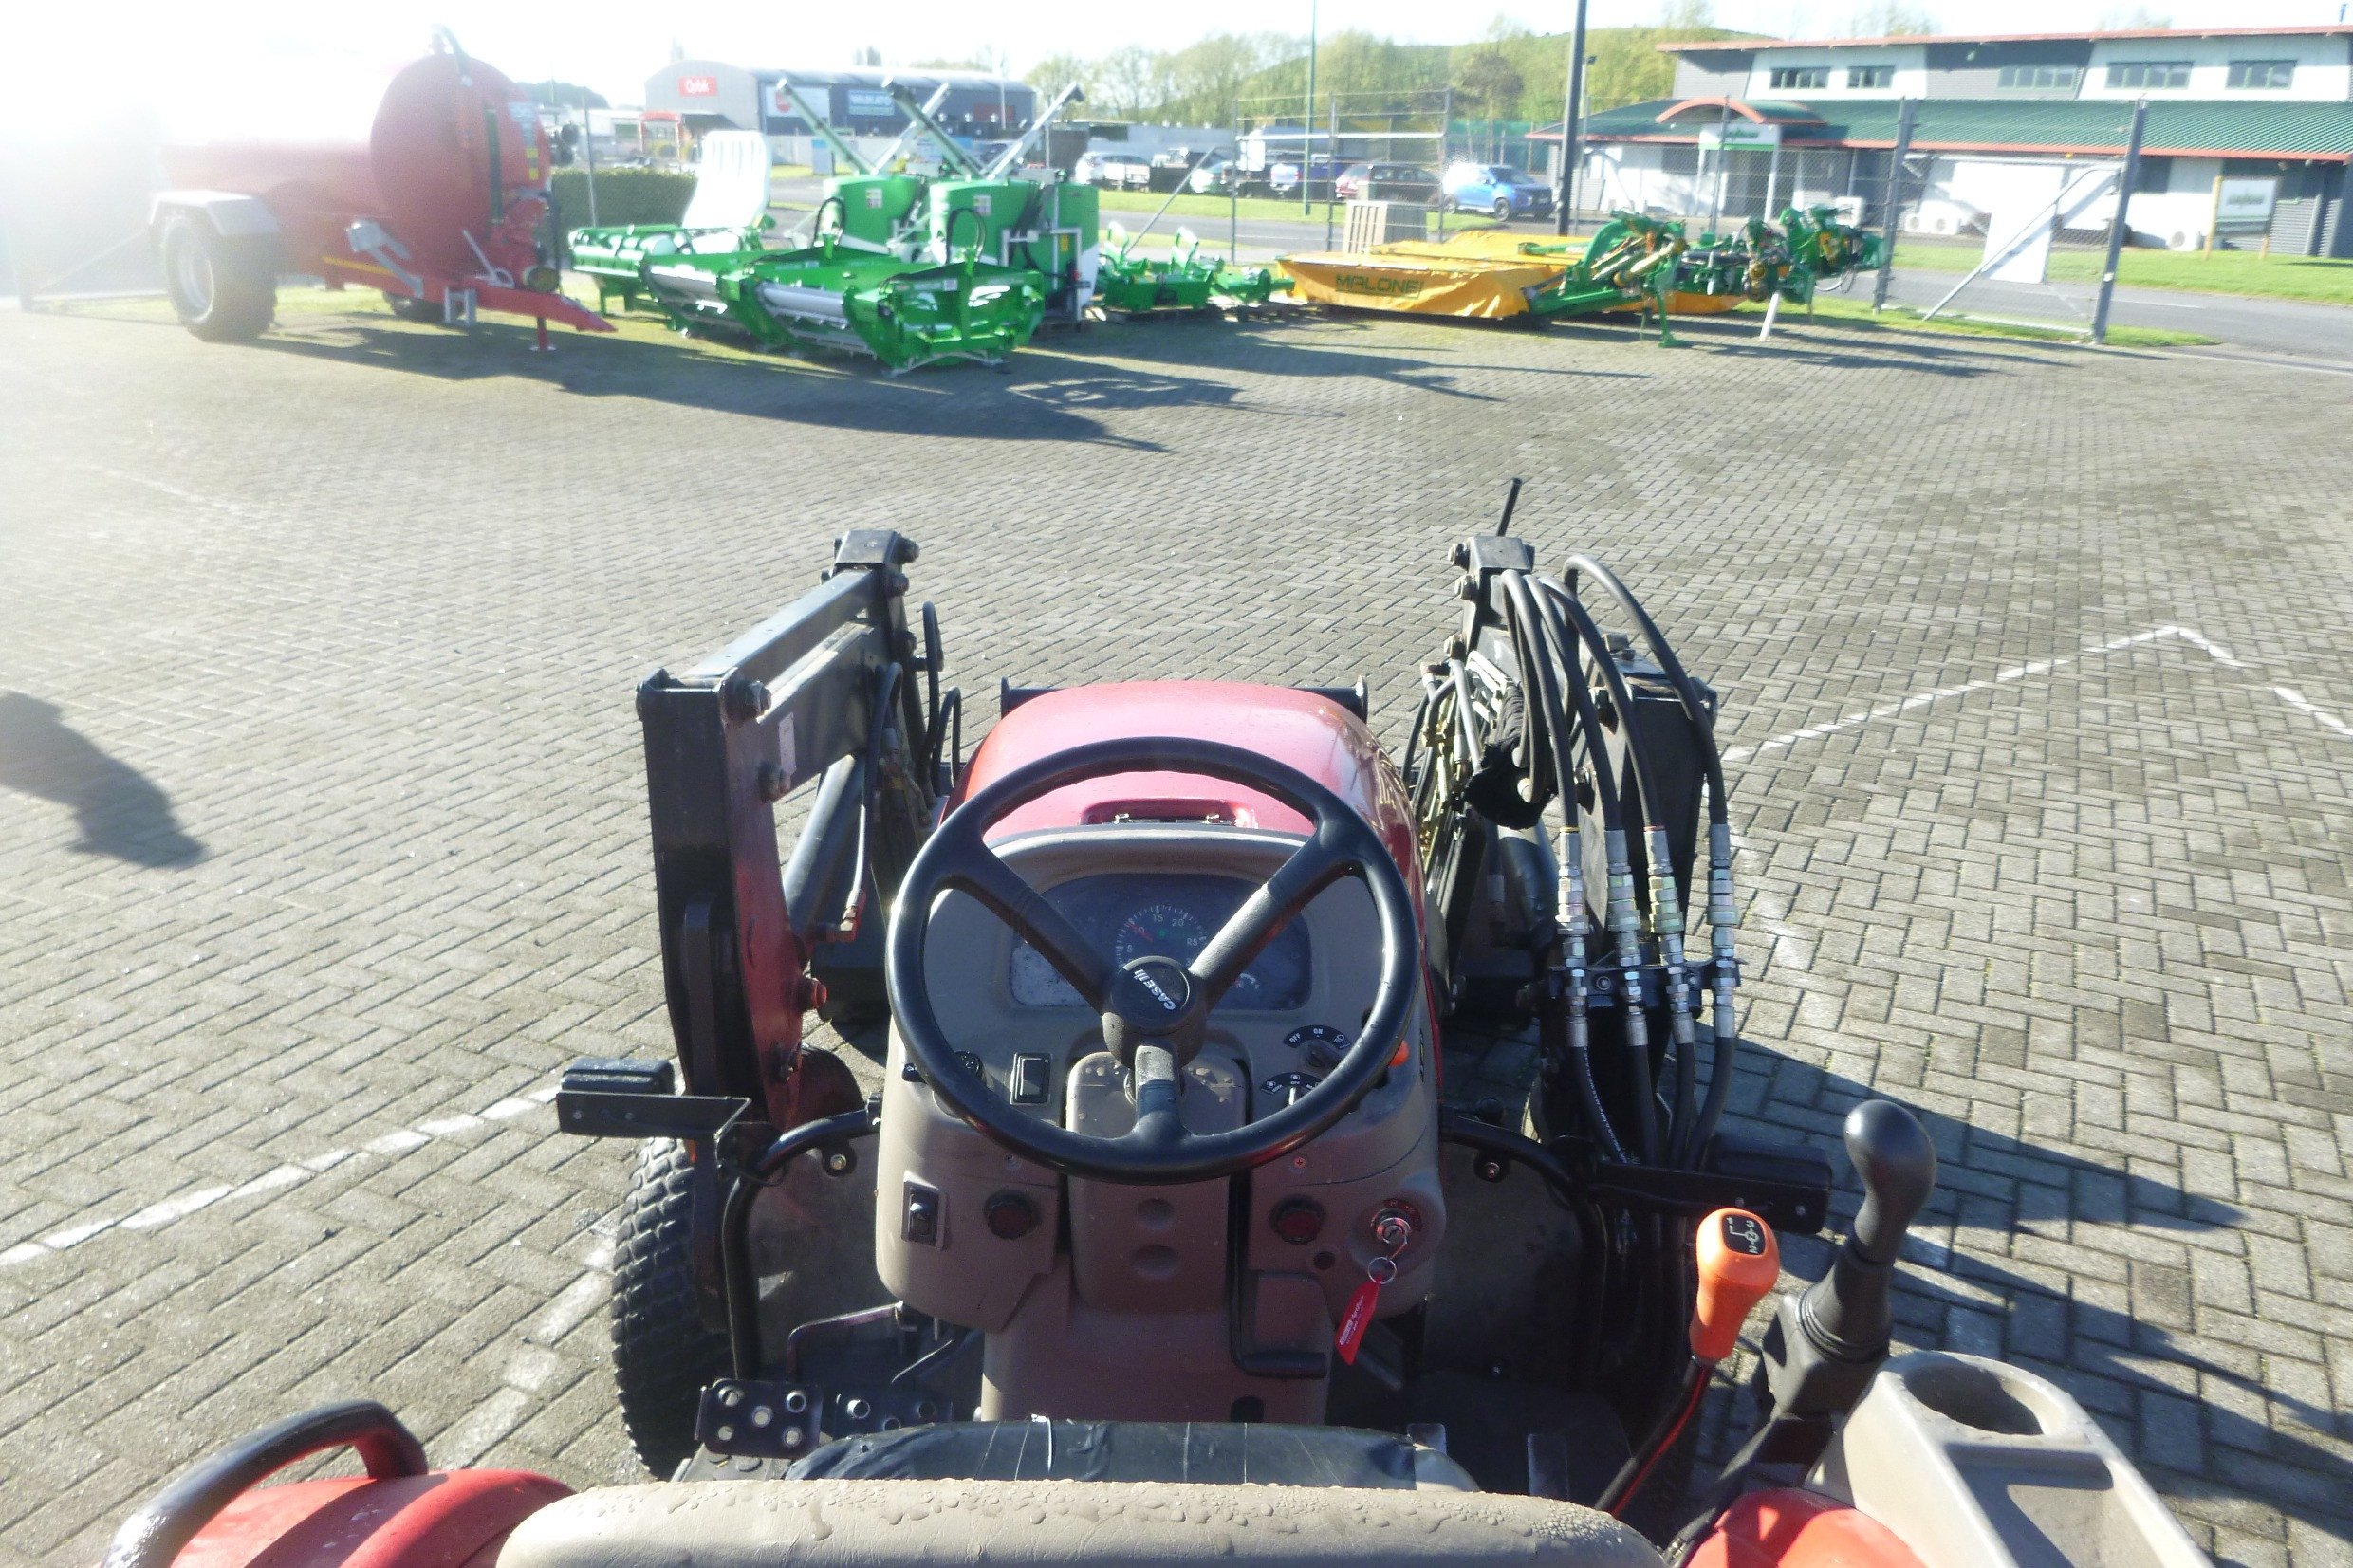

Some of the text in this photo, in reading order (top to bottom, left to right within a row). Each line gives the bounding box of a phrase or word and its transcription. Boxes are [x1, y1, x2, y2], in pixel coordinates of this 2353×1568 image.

[1336, 274, 1419, 293] MALONE
[1153, 913, 1163, 923] 15
[1172, 918, 1185, 927] 20
[1126, 944, 1133, 953] 5
[1289, 1033, 1301, 1042] OFF
[1746, 1220, 1755, 1228] 3
[1749, 1245, 1759, 1254] 2
